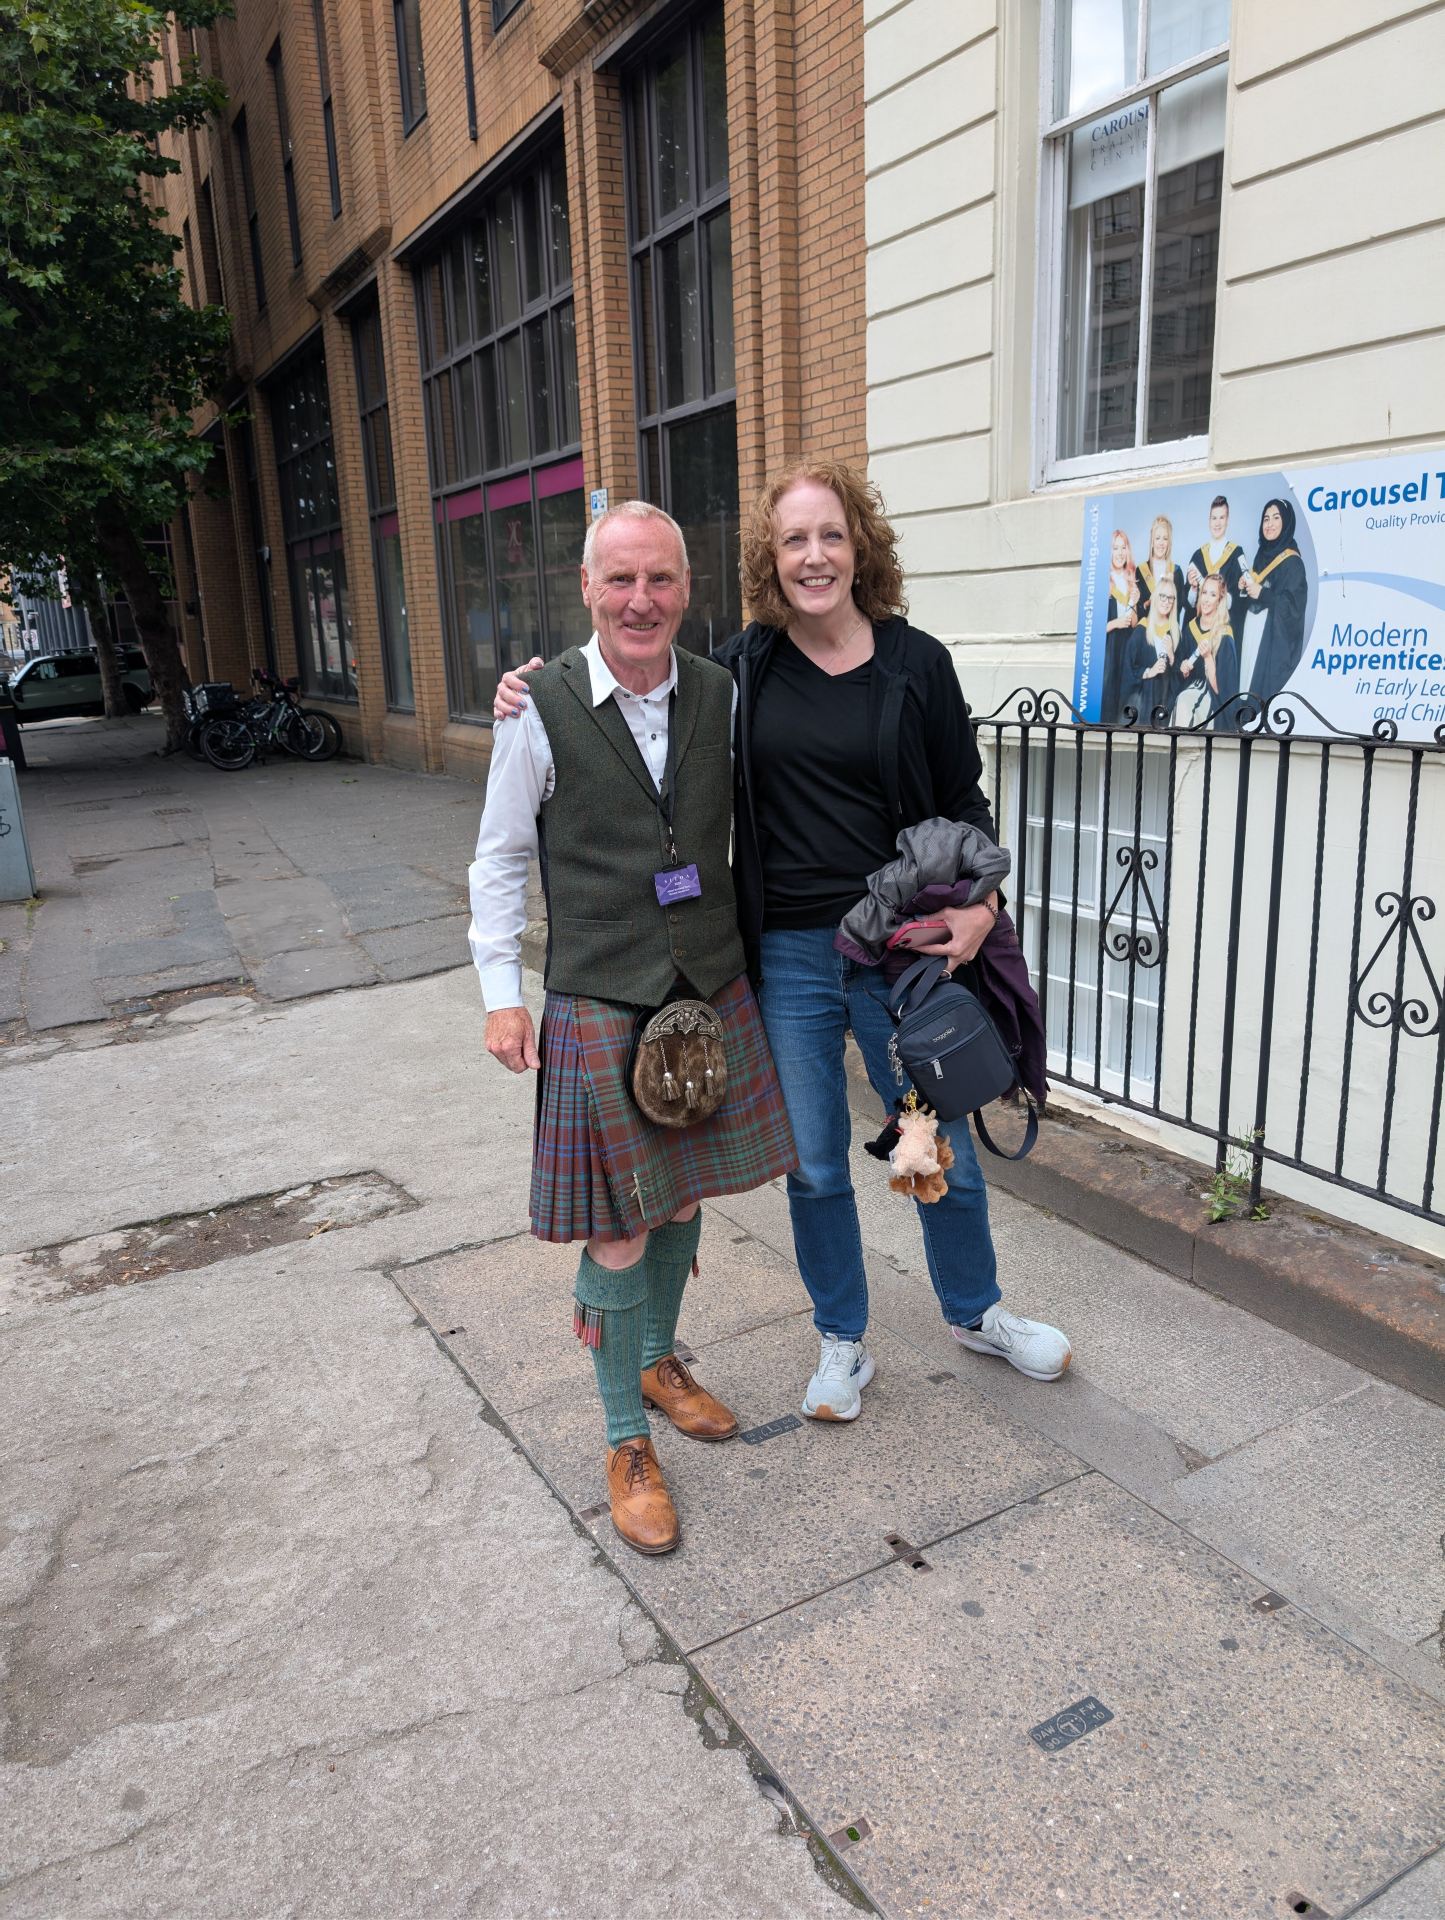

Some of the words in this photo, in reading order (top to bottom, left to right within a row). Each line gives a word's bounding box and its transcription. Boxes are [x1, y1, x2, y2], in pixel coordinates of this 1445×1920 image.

[1307, 472, 1429, 513] Carousel
[1365, 514, 1408, 530] Quality
[1331, 621, 1428, 647] Modern
[1355, 678, 1371, 695] in
[1375, 678, 1418, 701] Early
[1373, 703, 1408, 721] and
[1032, 1725, 1056, 1741] DAW
